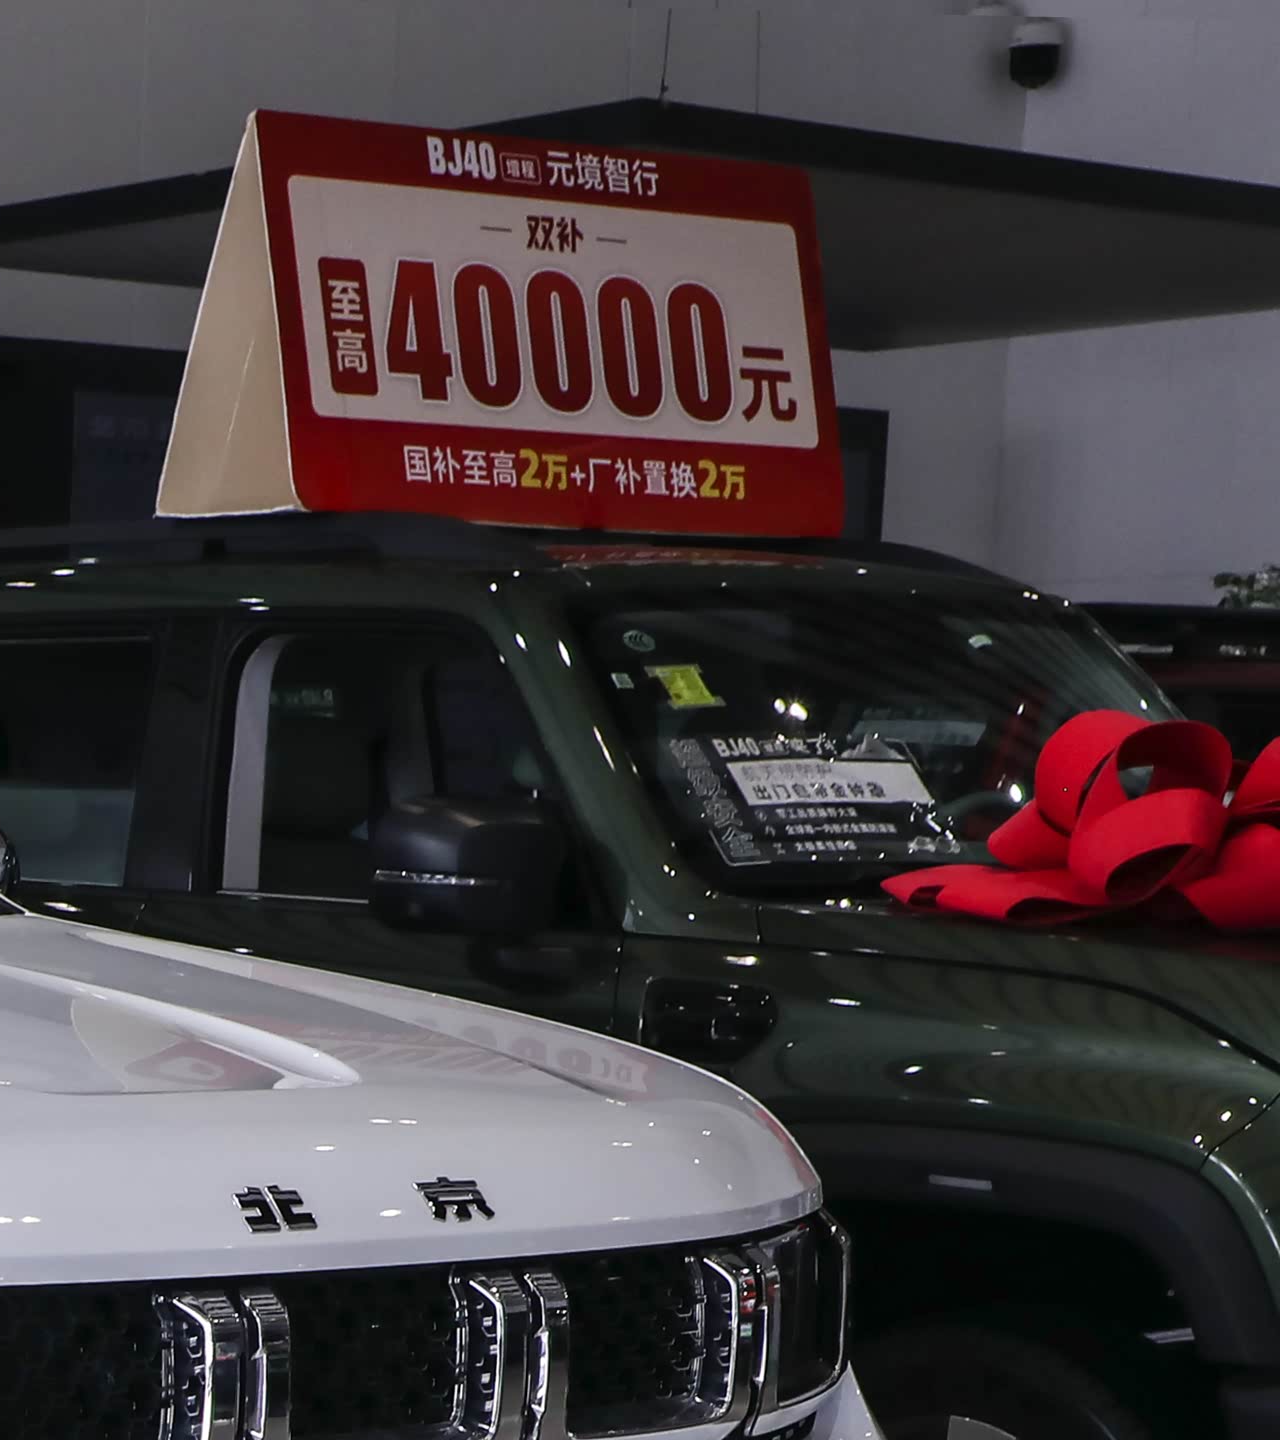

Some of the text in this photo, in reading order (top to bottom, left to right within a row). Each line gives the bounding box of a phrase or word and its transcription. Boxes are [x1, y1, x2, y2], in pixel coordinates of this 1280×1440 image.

[426, 135, 660, 197] BJ40 增程 元境智行
[526, 215, 585, 254] 双补
[328, 279, 369, 376] 至高
[403, 445, 746, 501] 国补至高2万+厂补置换2万
[712, 736, 760, 757] BJ40
[231, 1175, 496, 1234] 北京
